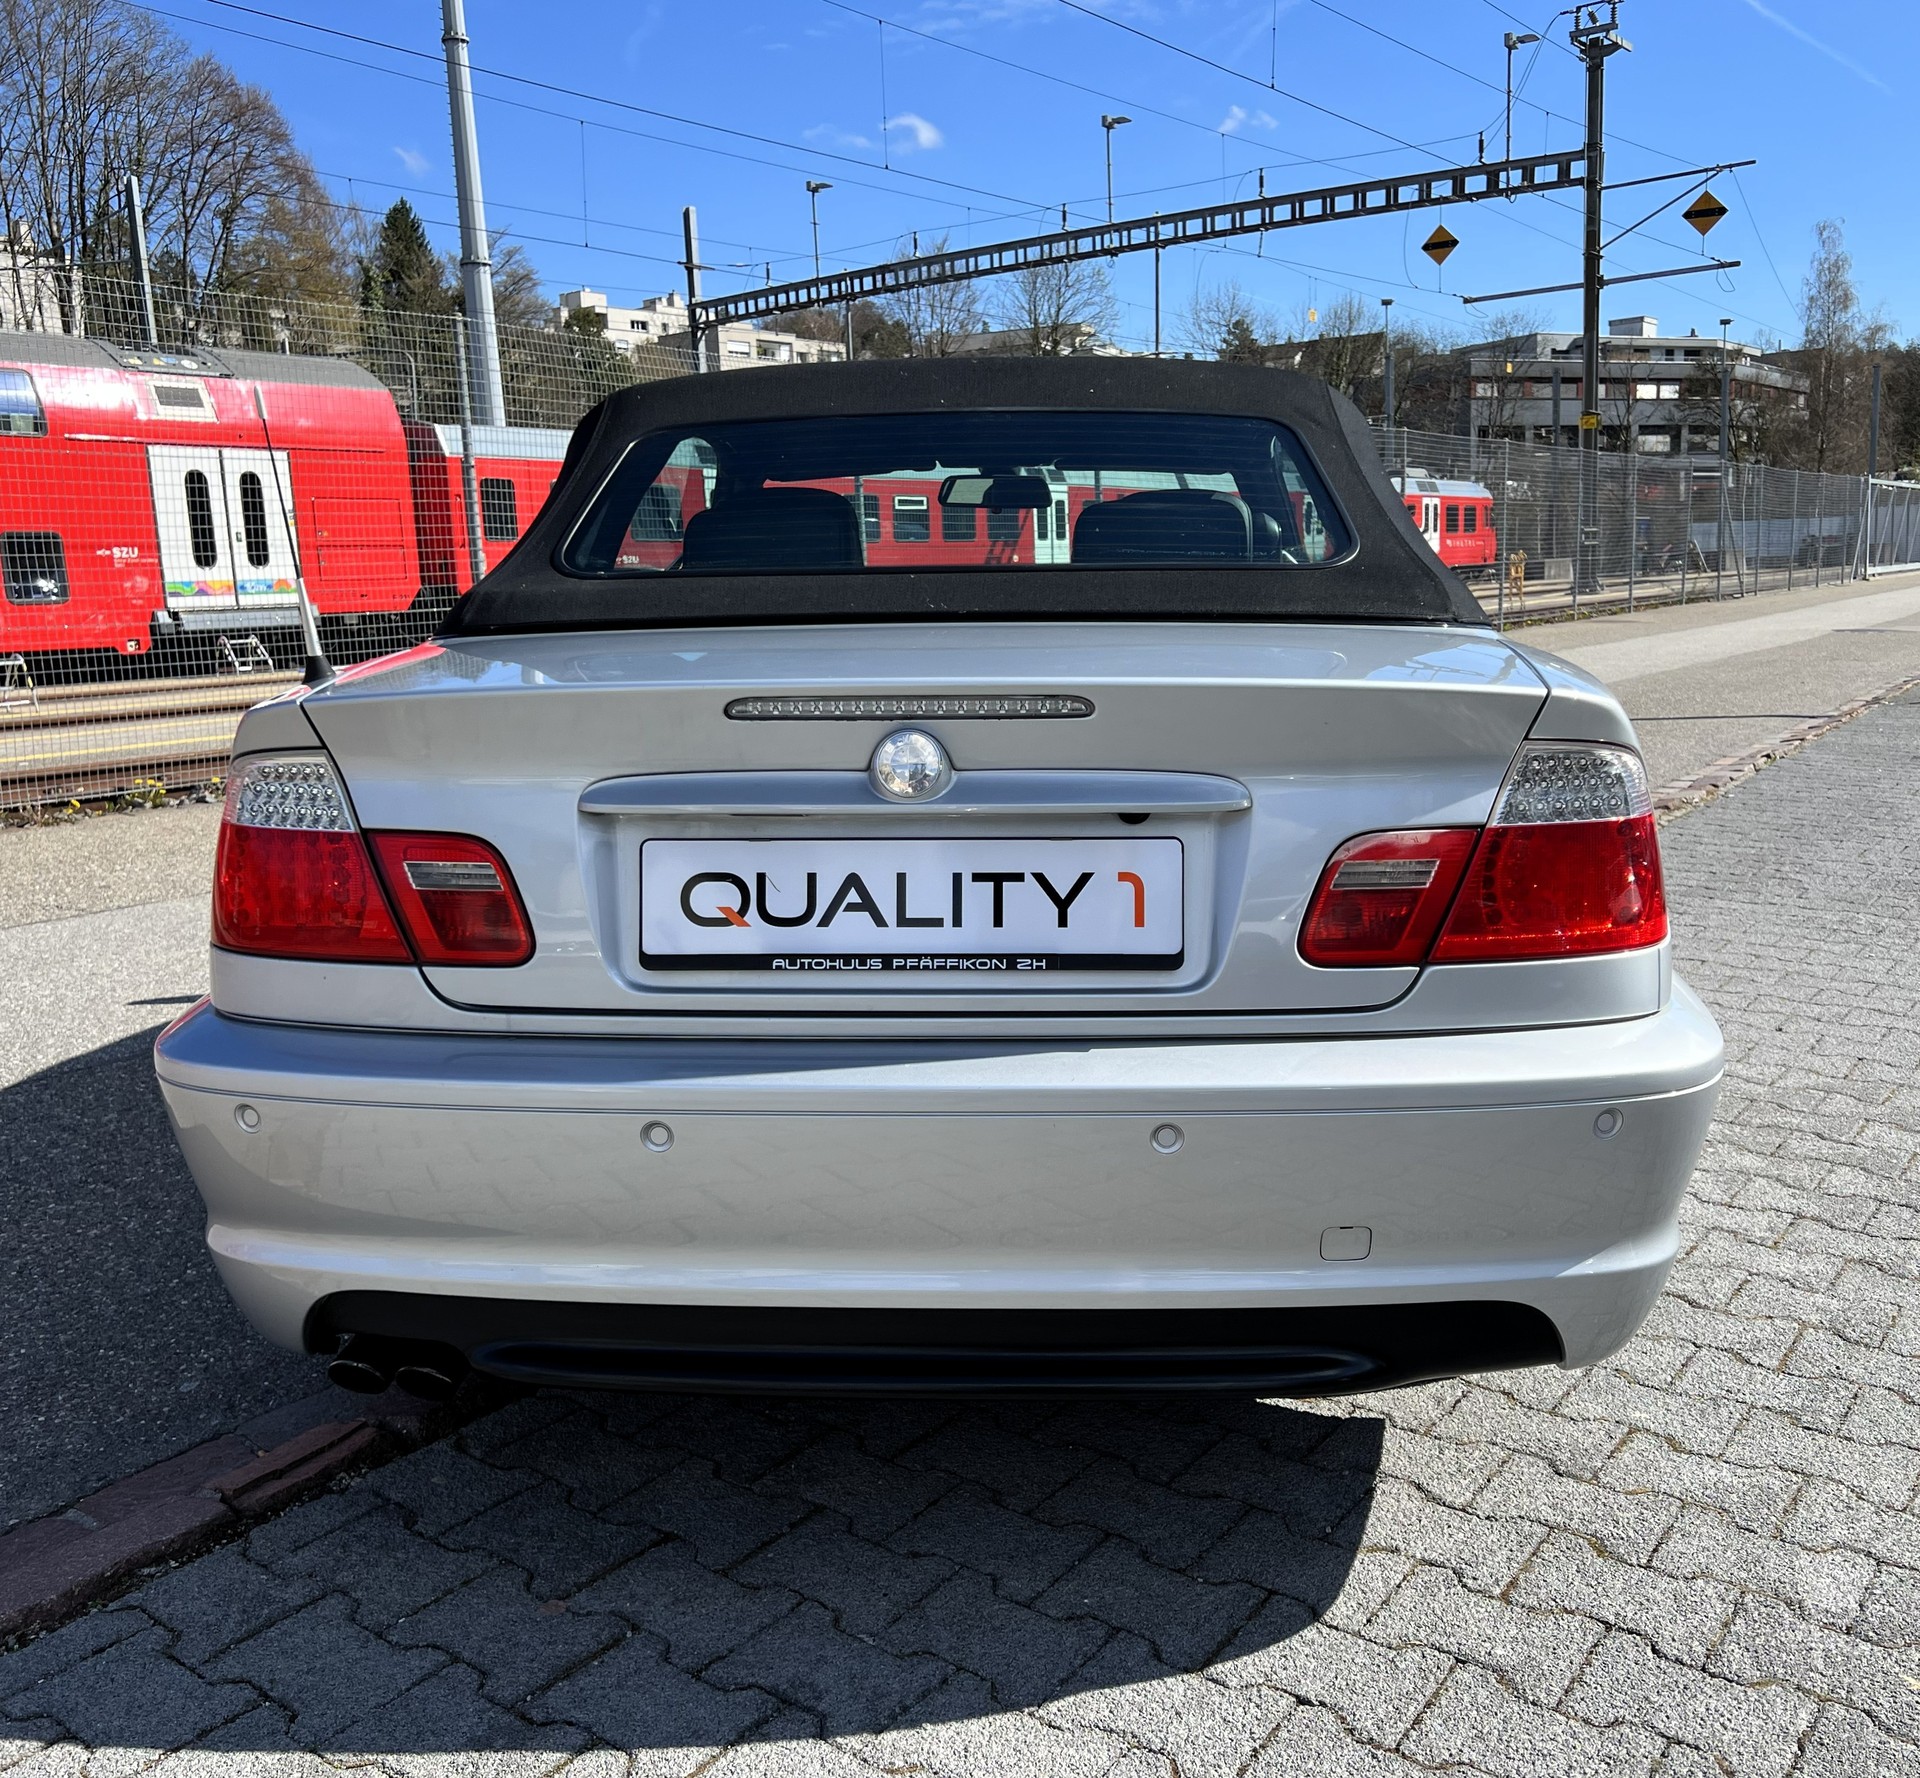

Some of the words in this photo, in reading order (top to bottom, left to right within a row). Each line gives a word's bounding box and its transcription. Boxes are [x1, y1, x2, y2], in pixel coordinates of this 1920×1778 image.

[112, 546, 138, 558] SZU
[681, 872, 1095, 928] QUALITY
[1117, 872, 1145, 928] 1
[772, 958, 882, 970] AUTOHUUS
[893, 956, 1006, 970] PFÄFFIKON
[1017, 958, 1046, 970] ZH
